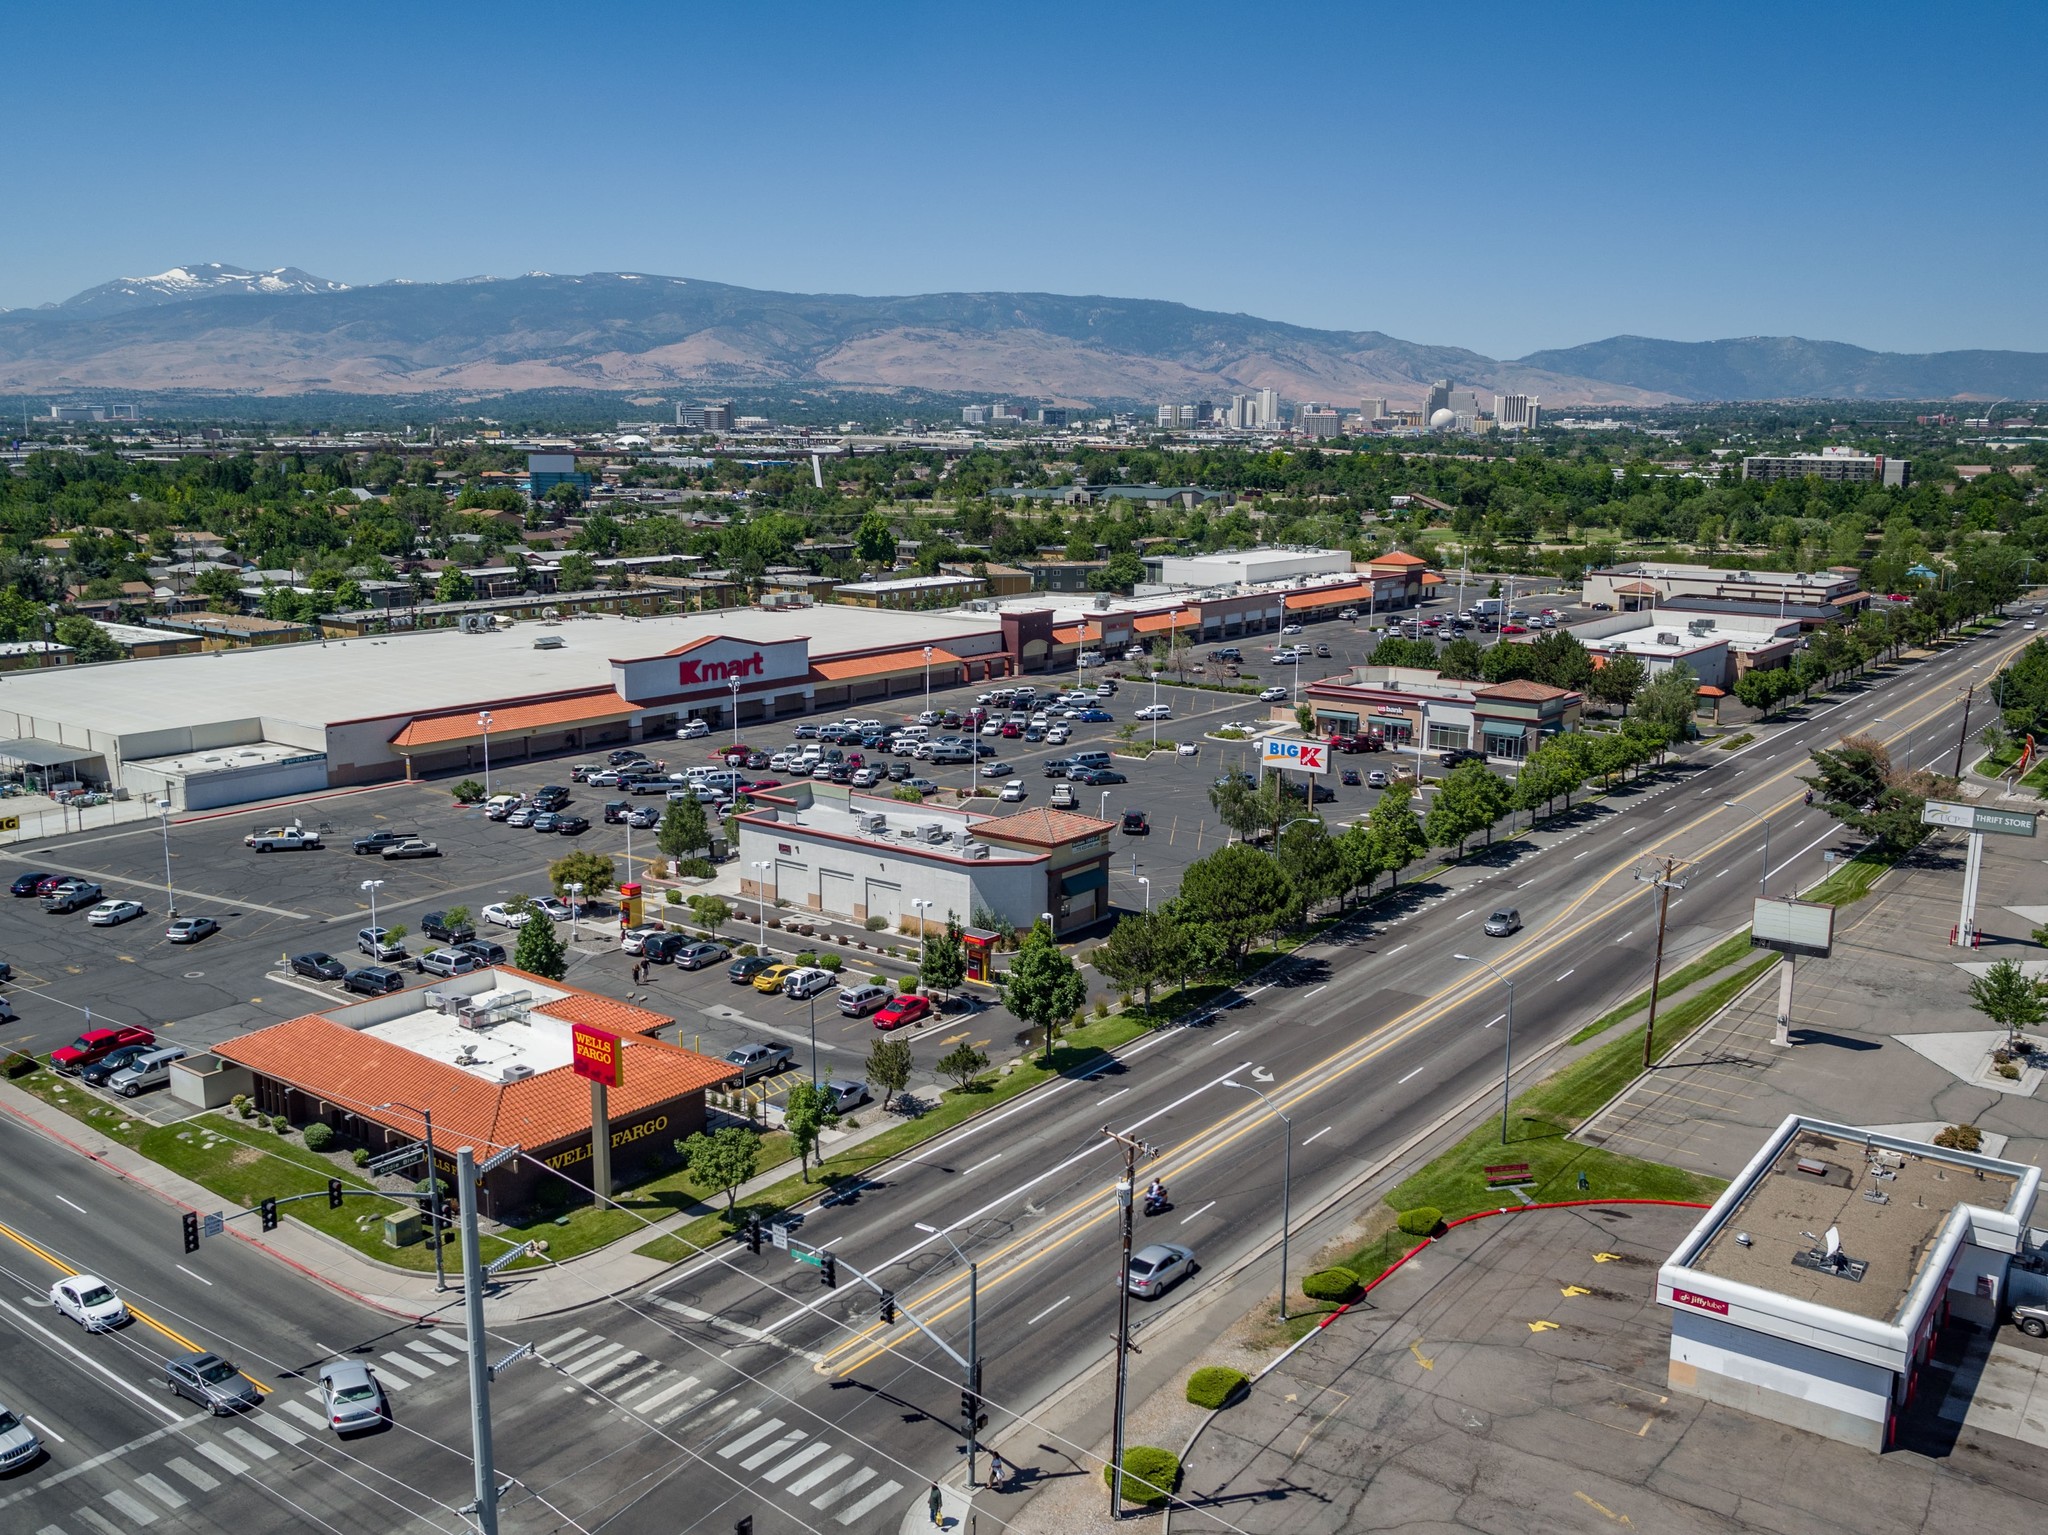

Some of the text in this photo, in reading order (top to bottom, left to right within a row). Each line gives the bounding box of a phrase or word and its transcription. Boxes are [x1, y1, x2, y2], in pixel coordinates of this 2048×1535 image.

[679, 651, 764, 685] Kmart
[1270, 742, 1322, 768] BIG K
[1940, 814, 1961, 824] UCP
[1976, 814, 2003, 824] THRIFT
[2004, 819, 2032, 828] STORE
[575, 1031, 611, 1053] WELLS
[576, 1043, 611, 1064] FARGO
[545, 1116, 668, 1170] WELL FARGO
[380, 1156, 418, 1173] Oddie Blvd
